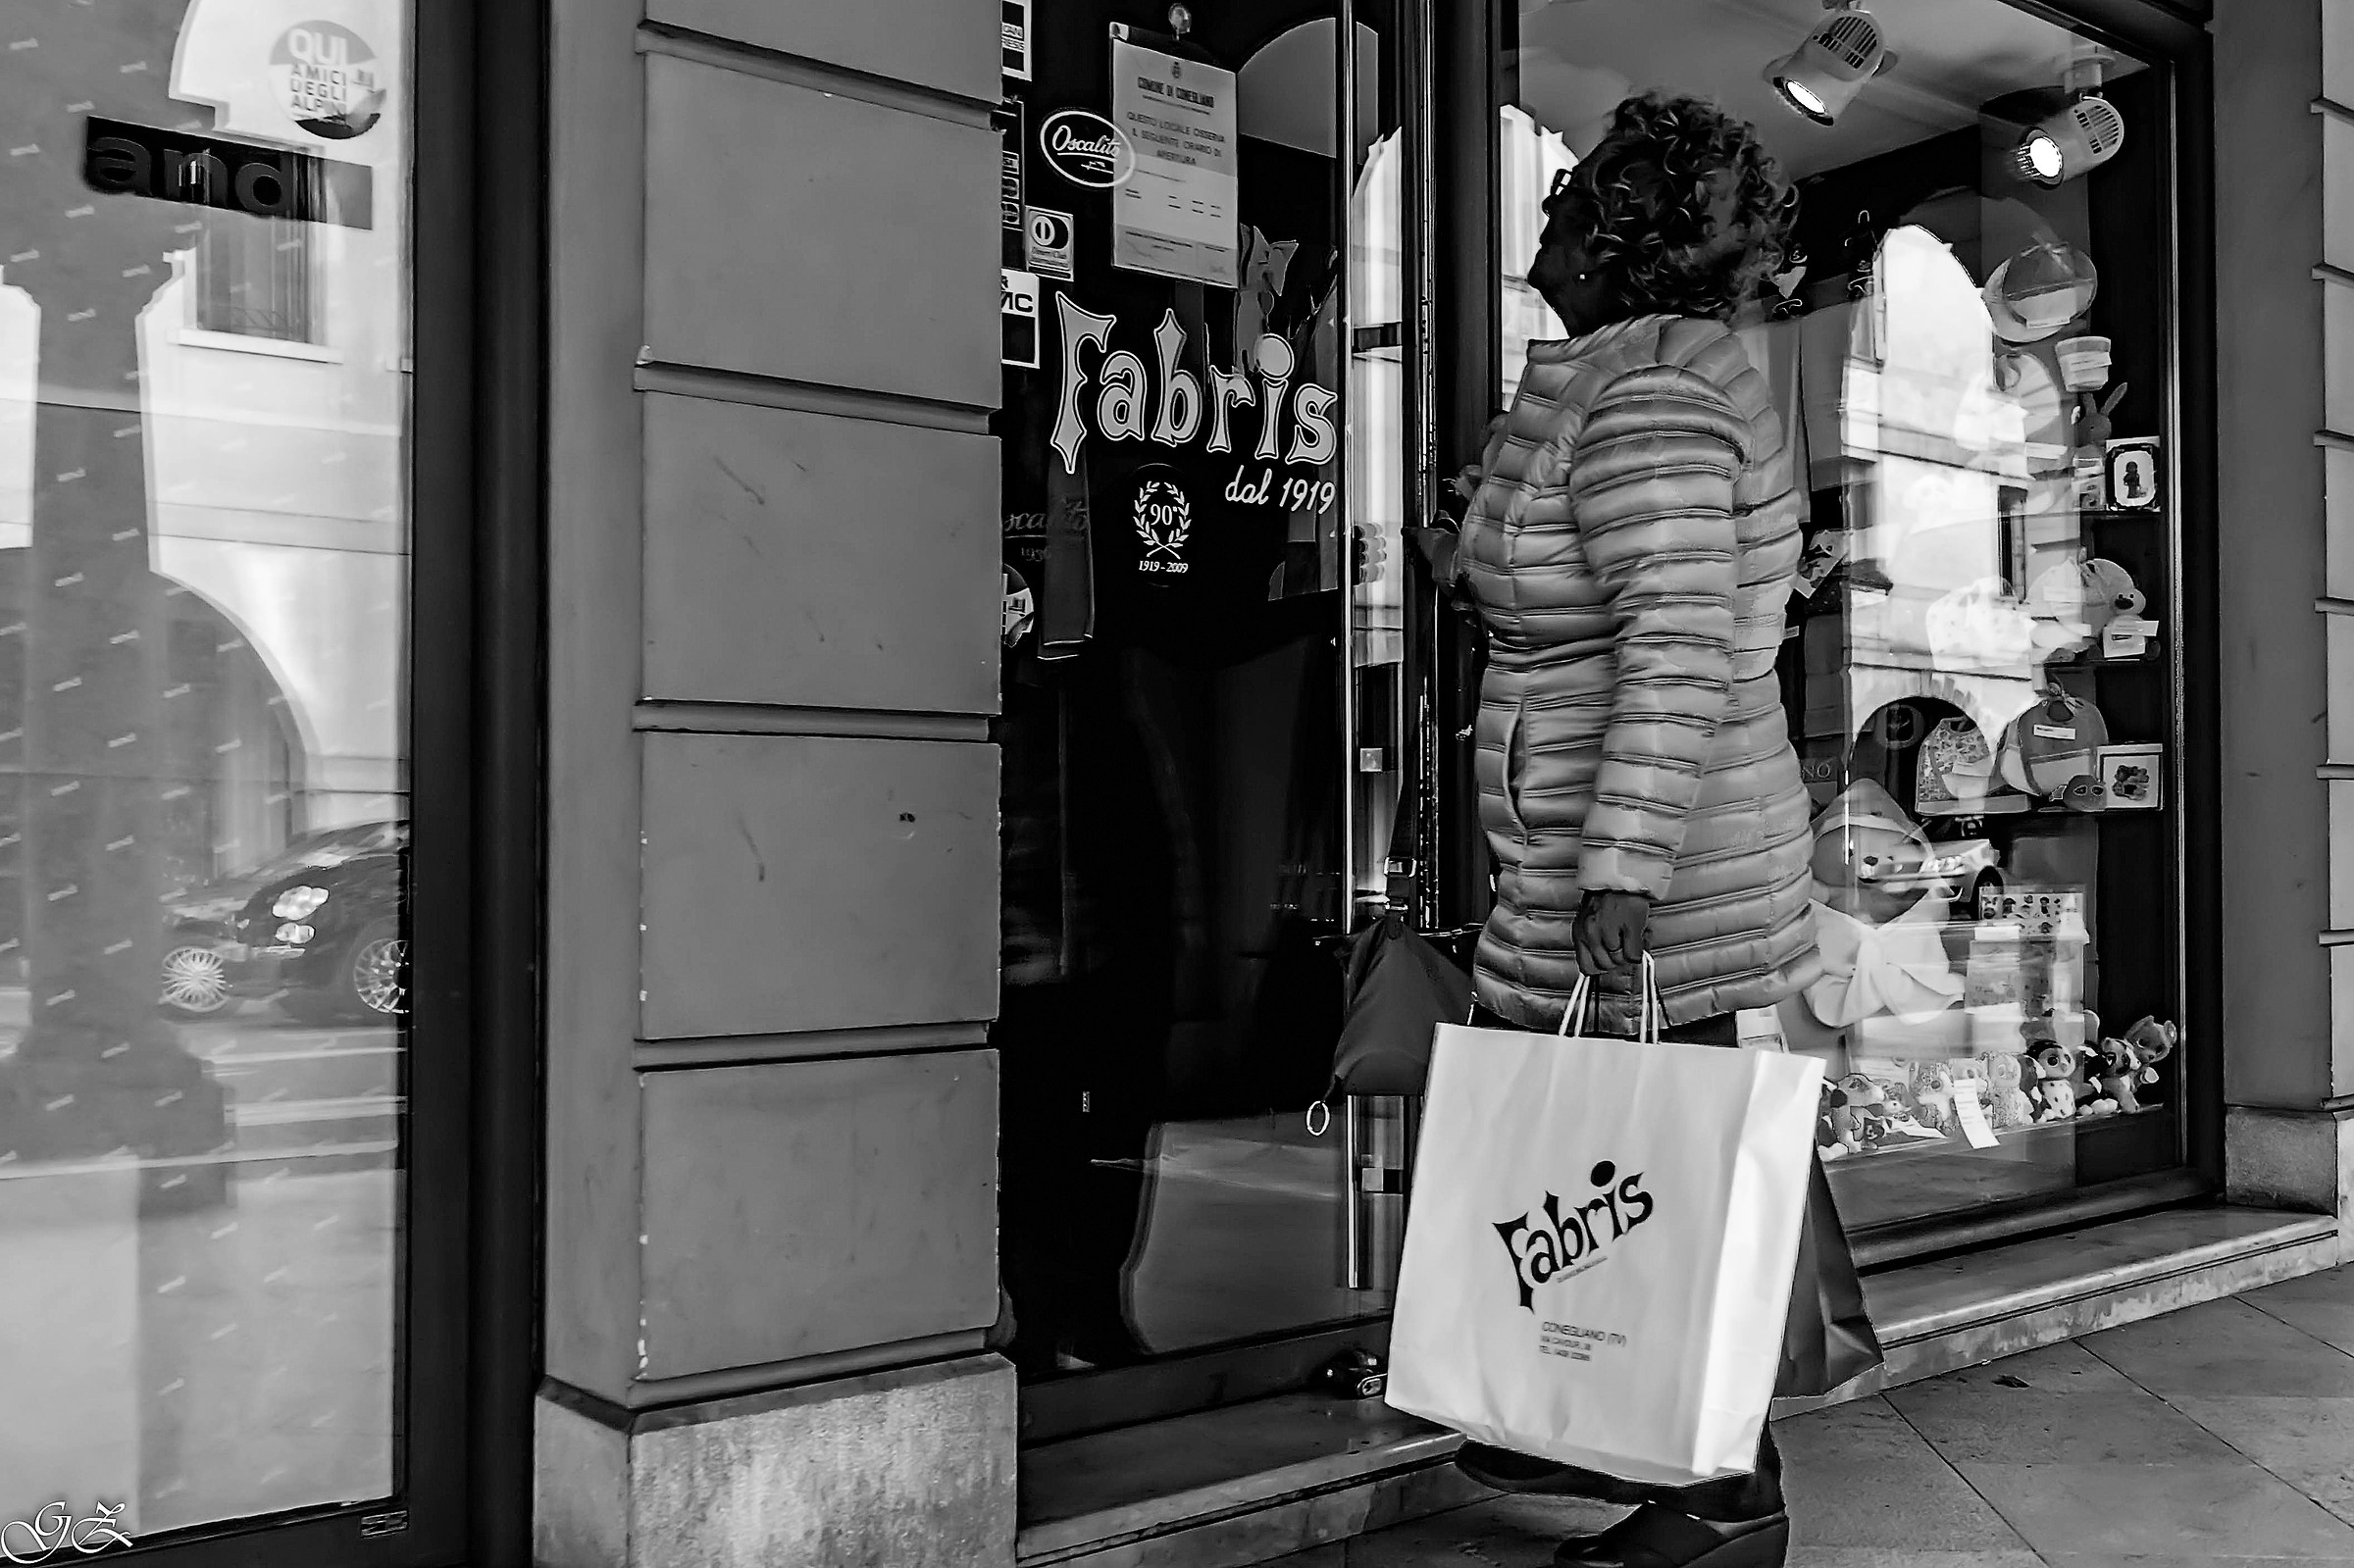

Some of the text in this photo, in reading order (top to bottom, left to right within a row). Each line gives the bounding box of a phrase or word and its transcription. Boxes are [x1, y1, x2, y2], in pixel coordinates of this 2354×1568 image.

[287, 28, 347, 65] QUI
[290, 62, 346, 86] AMICI
[290, 78, 346, 102] DEGLI
[1049, 290, 1339, 474] Fabris
[1225, 464, 1336, 515] dal 1919
[1491, 1159, 1655, 1316] Fabris
